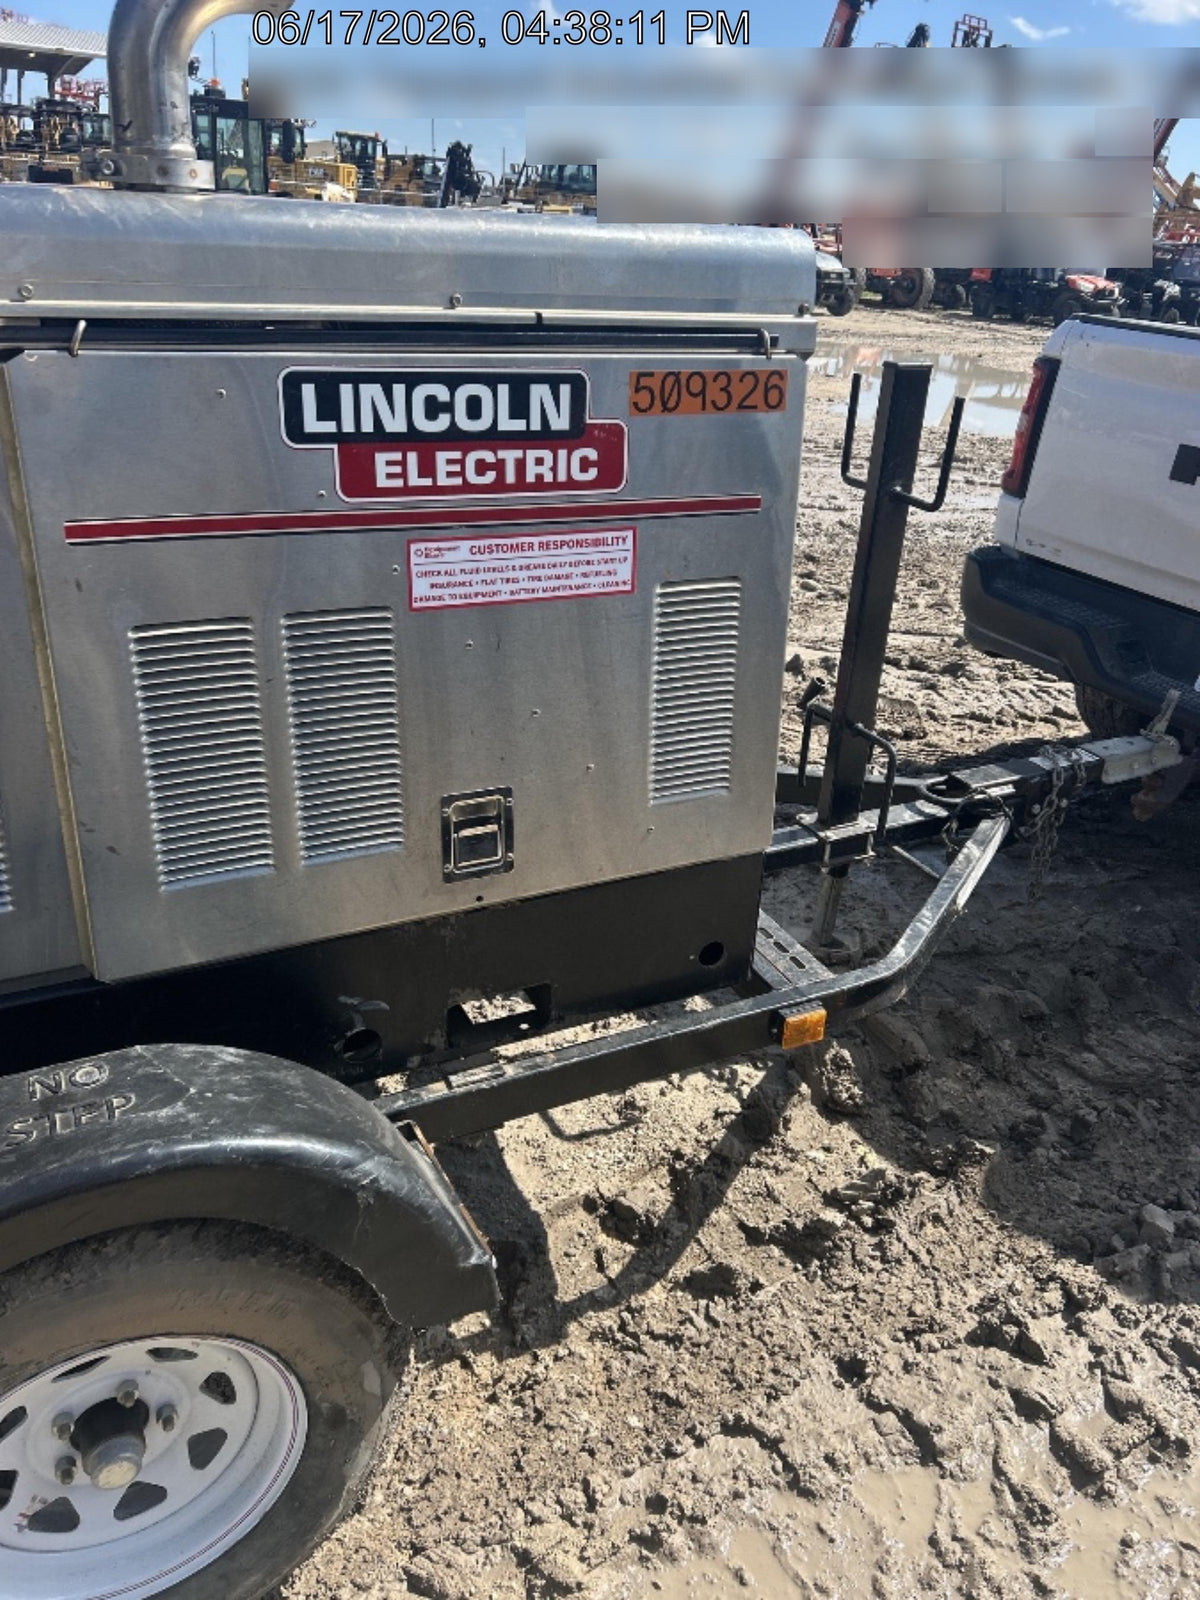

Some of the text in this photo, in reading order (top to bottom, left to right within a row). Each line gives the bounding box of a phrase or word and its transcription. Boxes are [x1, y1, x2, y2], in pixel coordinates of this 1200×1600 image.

[301, 382, 572, 434] LINCOLN
[632, 371, 786, 413] 509326
[374, 448, 599, 489] ELECTRIC
[469, 535, 628, 556] CUSTOMER RESPONSIBILITY
[27, 1062, 110, 1102] NO
